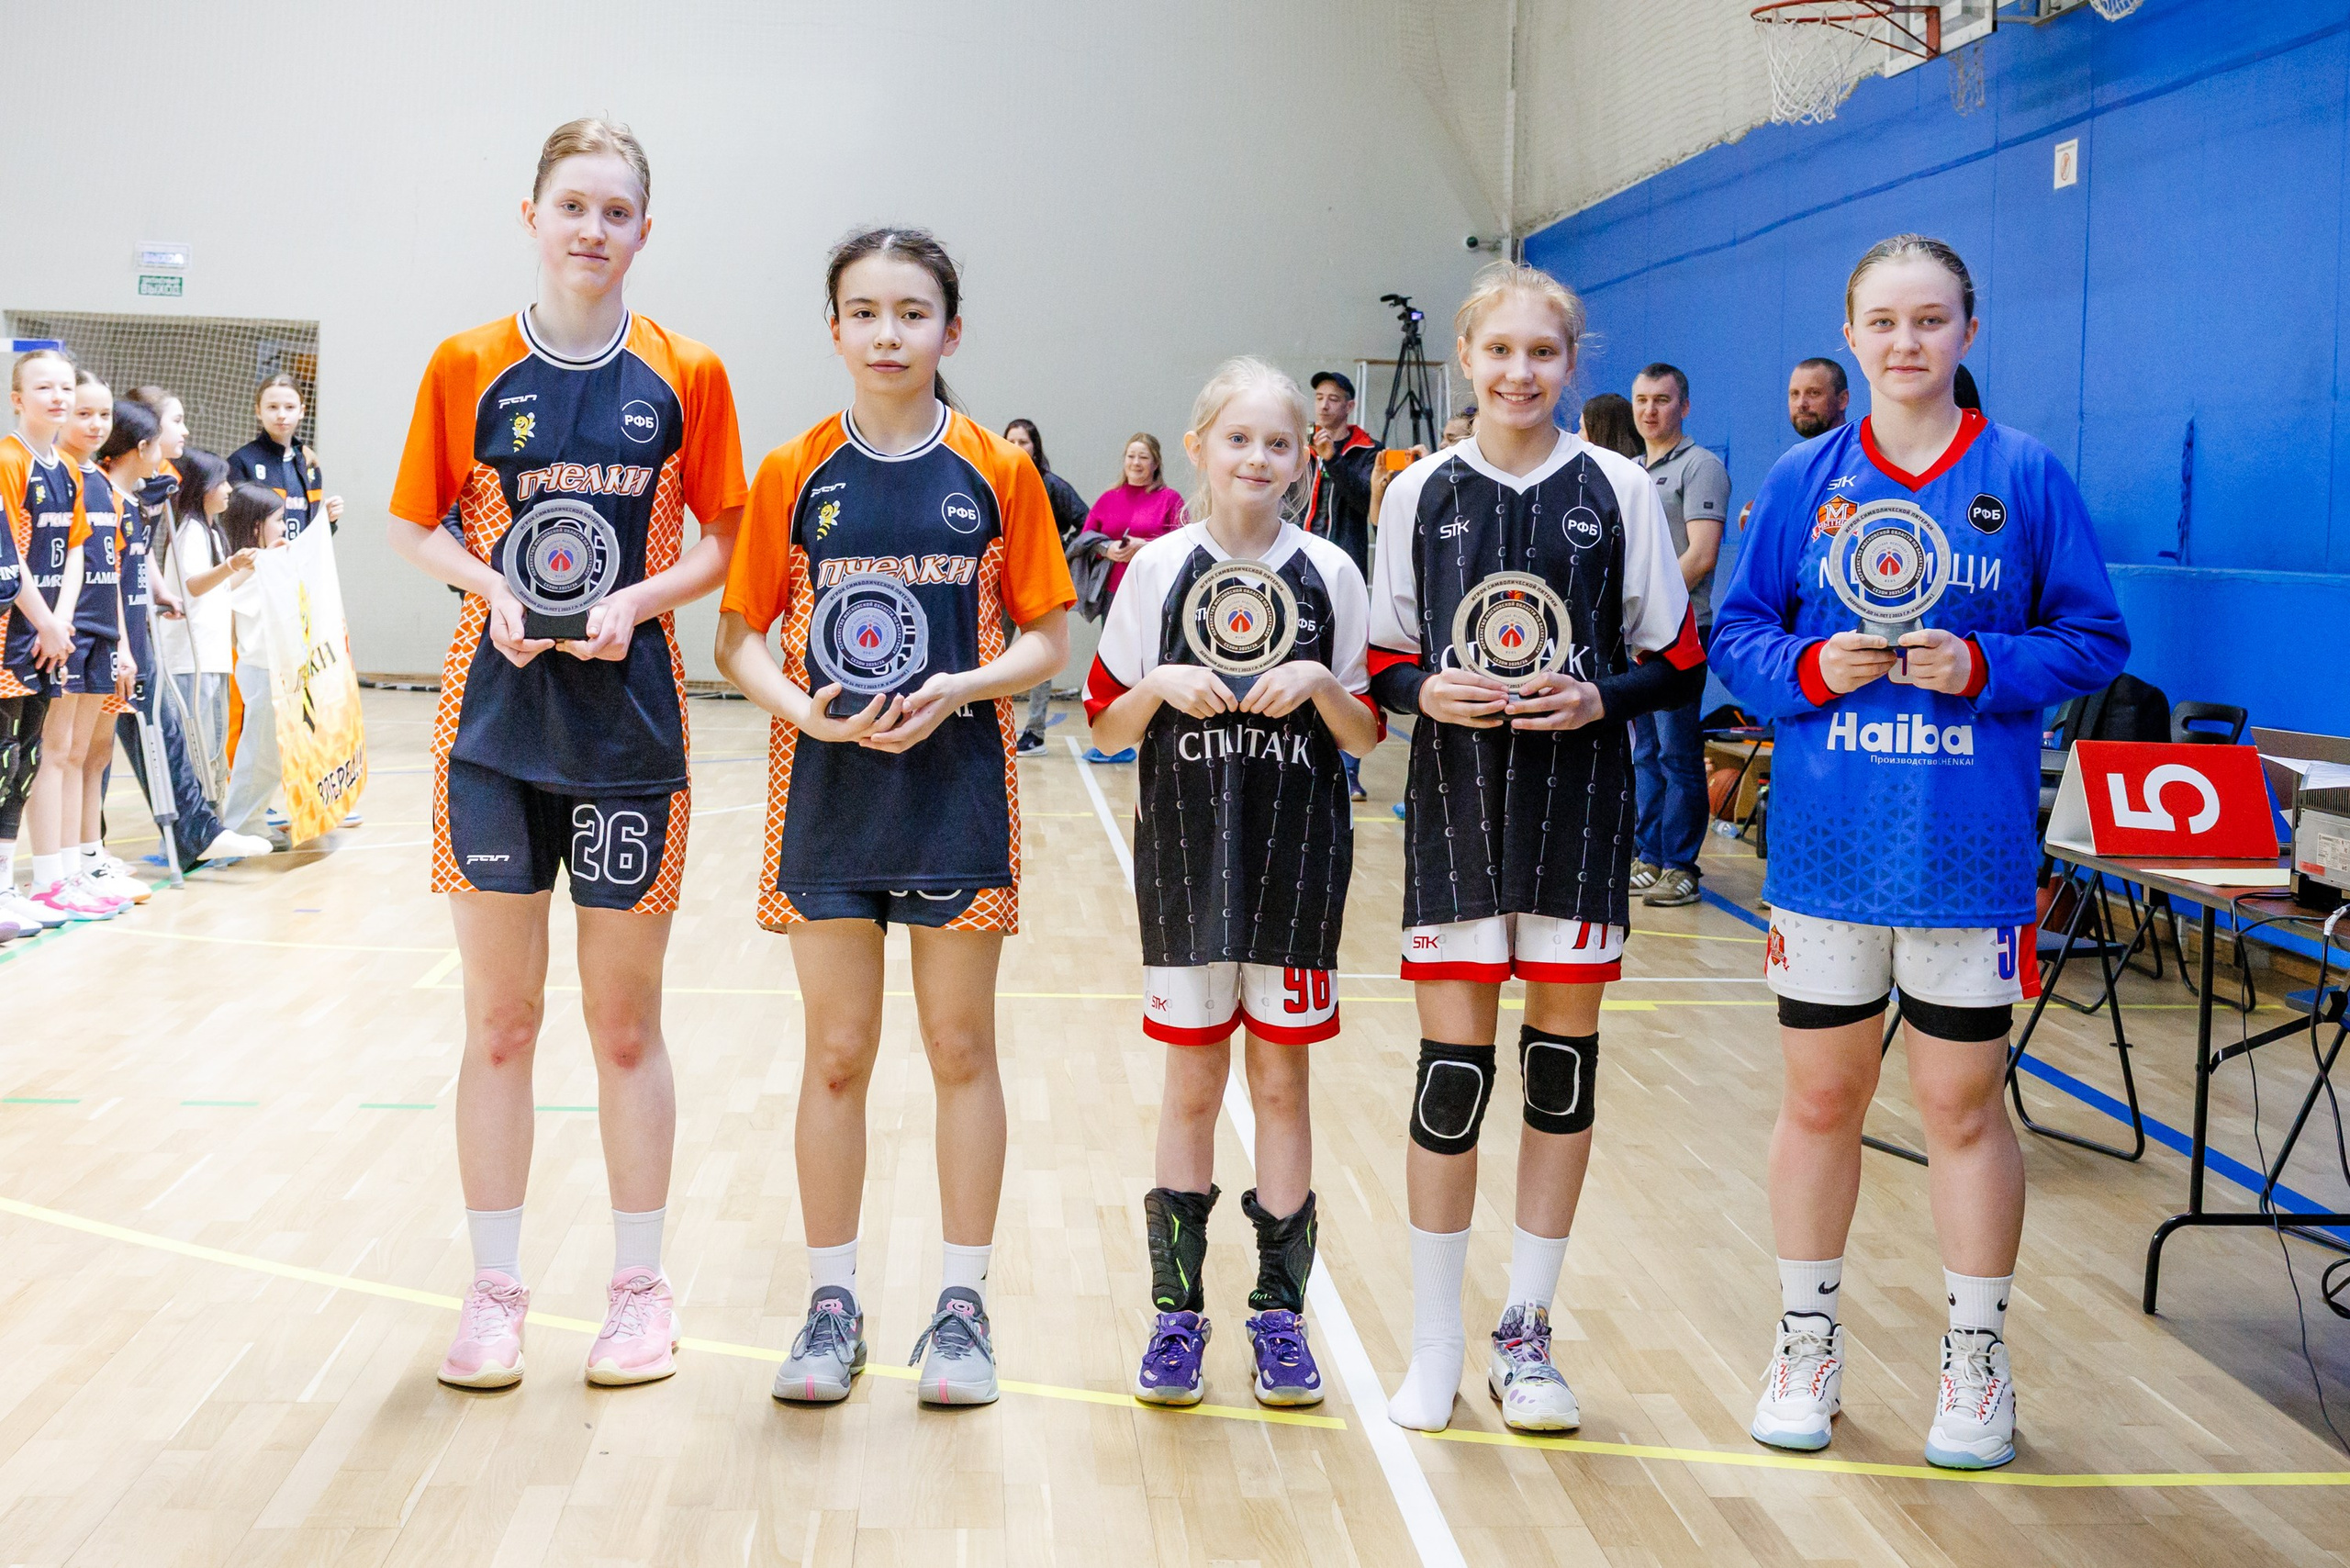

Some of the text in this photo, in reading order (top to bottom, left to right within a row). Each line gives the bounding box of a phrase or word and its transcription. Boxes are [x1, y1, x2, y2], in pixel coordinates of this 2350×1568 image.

[624, 414, 655, 429] РФБ
[255, 464, 266, 480] 8
[1827, 476, 1857, 490] STK
[947, 506, 977, 521] РФБ
[1825, 503, 1850, 521] М
[1973, 507, 2001, 521] РФБ
[1440, 520, 1470, 539] STK
[1568, 520, 1598, 536] РФБ
[50, 537, 65, 568] 6
[1297, 618, 1316, 633] ФБ
[1827, 711, 1974, 756] Haiba
[2107, 764, 2221, 834] 5
[571, 803, 648, 885] 26
[1413, 935, 1439, 949] STK
[1283, 967, 1330, 1014] 98
[1151, 995, 1168, 1012] STK
